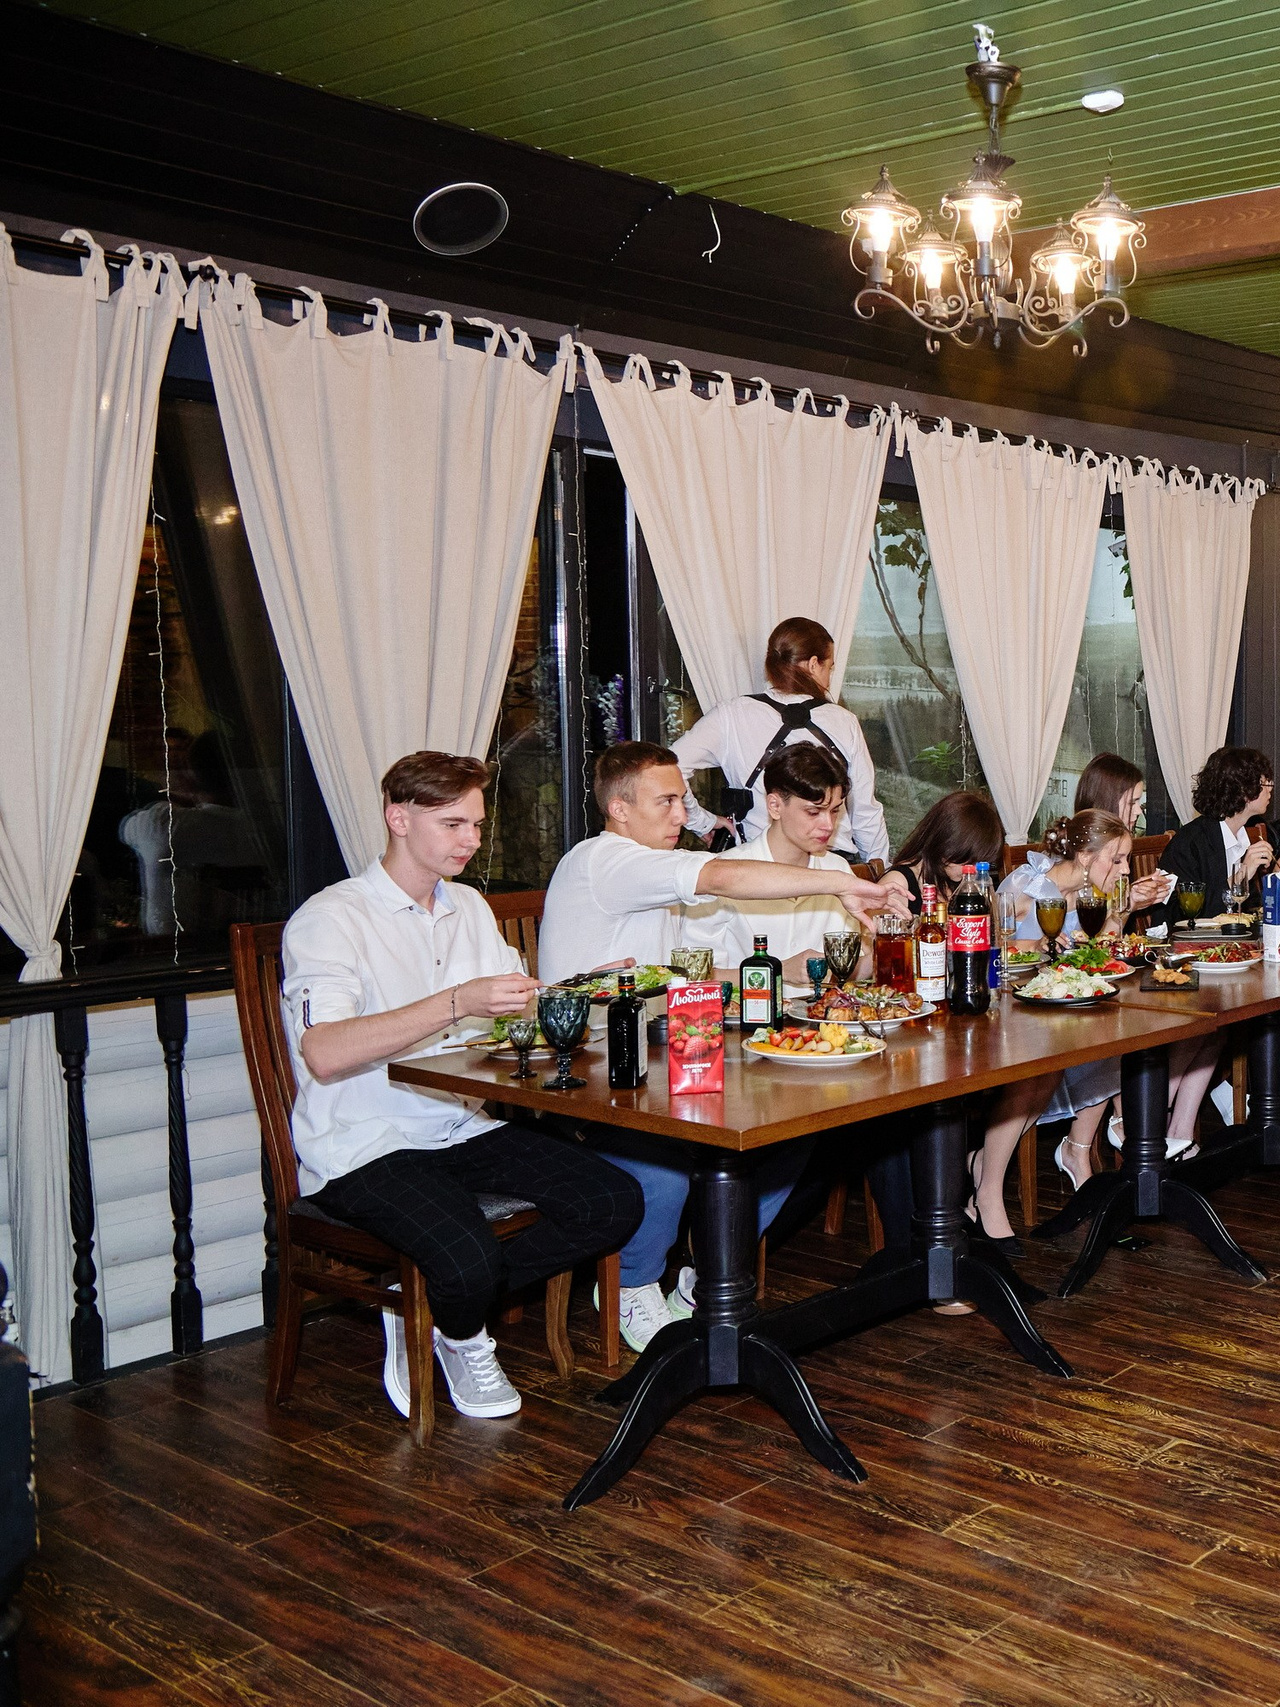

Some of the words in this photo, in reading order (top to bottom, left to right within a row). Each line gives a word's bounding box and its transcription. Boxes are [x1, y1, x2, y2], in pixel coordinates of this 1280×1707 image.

[957, 918, 985, 929] Export
[960, 927, 981, 939] Style
[669, 988, 721, 1009] Любимый
